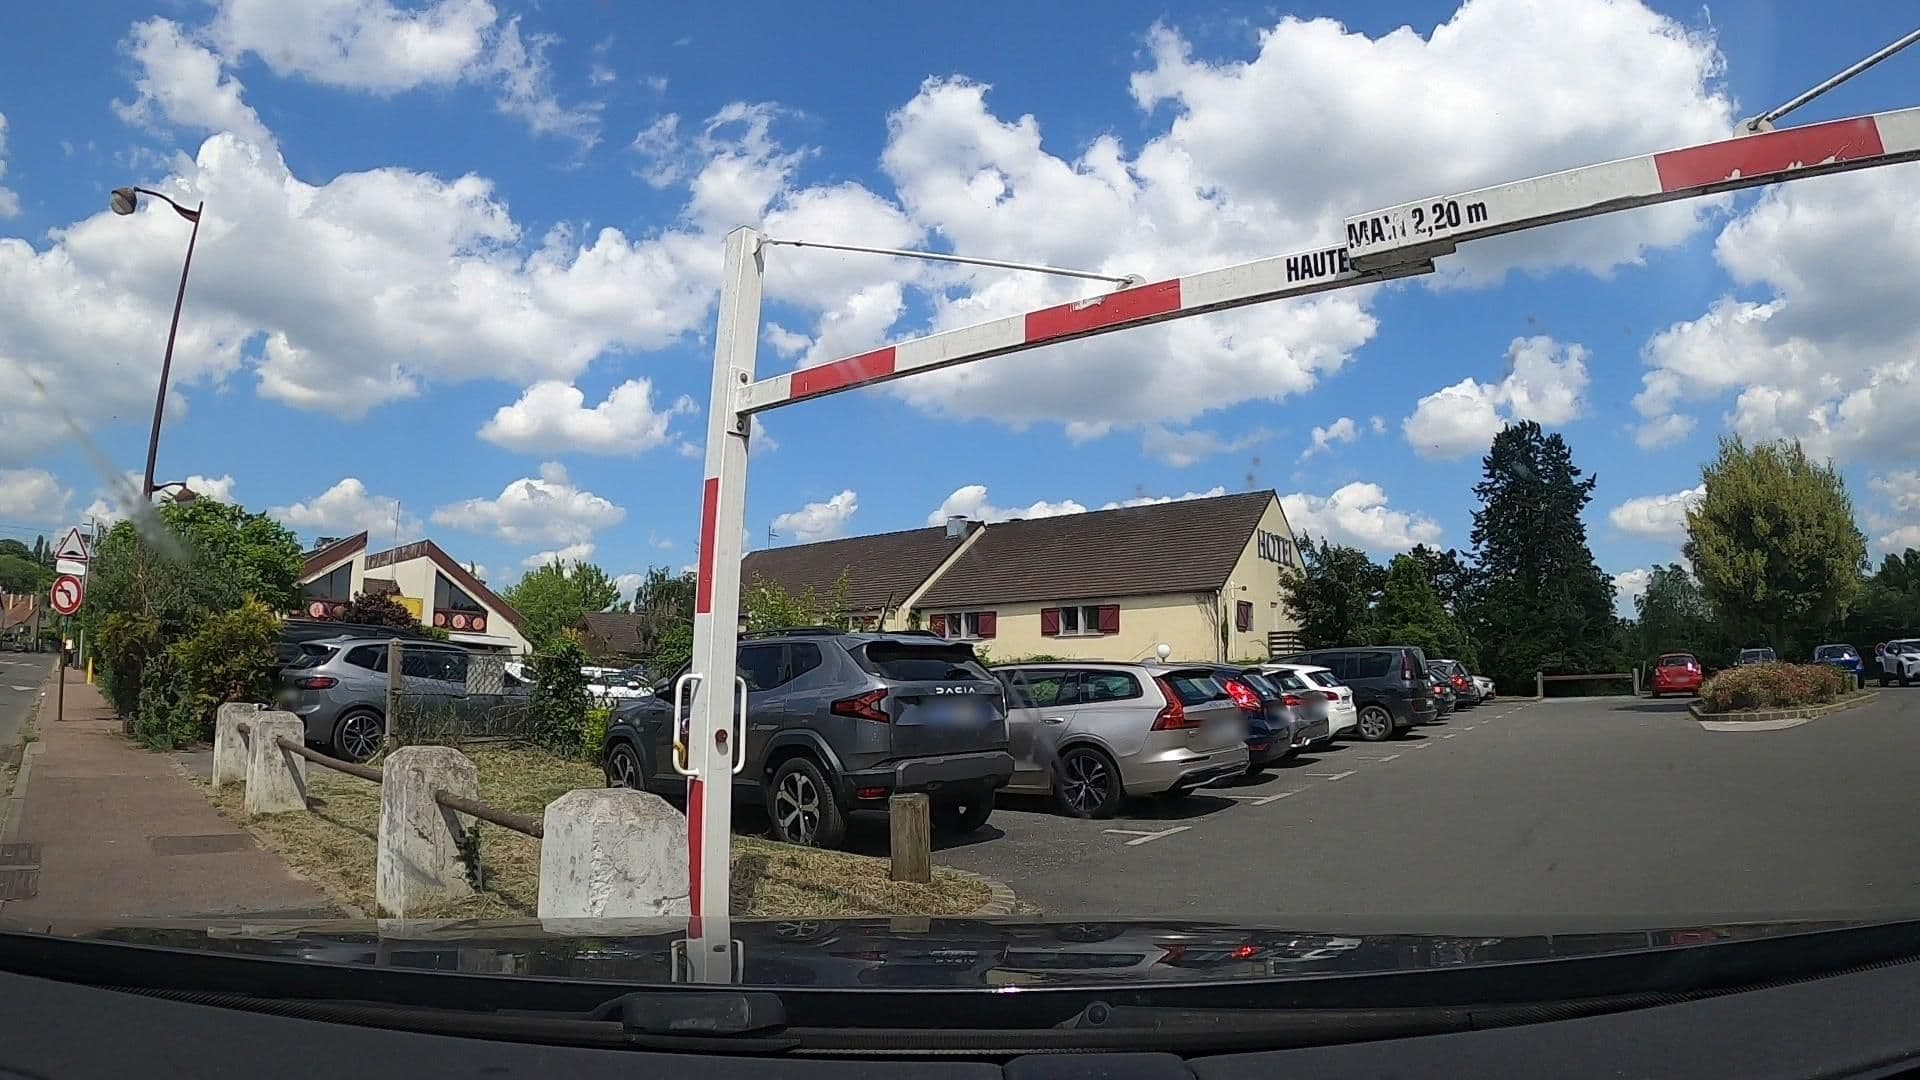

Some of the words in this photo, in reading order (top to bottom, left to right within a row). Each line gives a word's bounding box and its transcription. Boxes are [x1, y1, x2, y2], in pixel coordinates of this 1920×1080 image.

[1411, 200, 1461, 238] 2,20
[1466, 202, 1489, 224] m
[935, 686, 976, 695] DACIA
